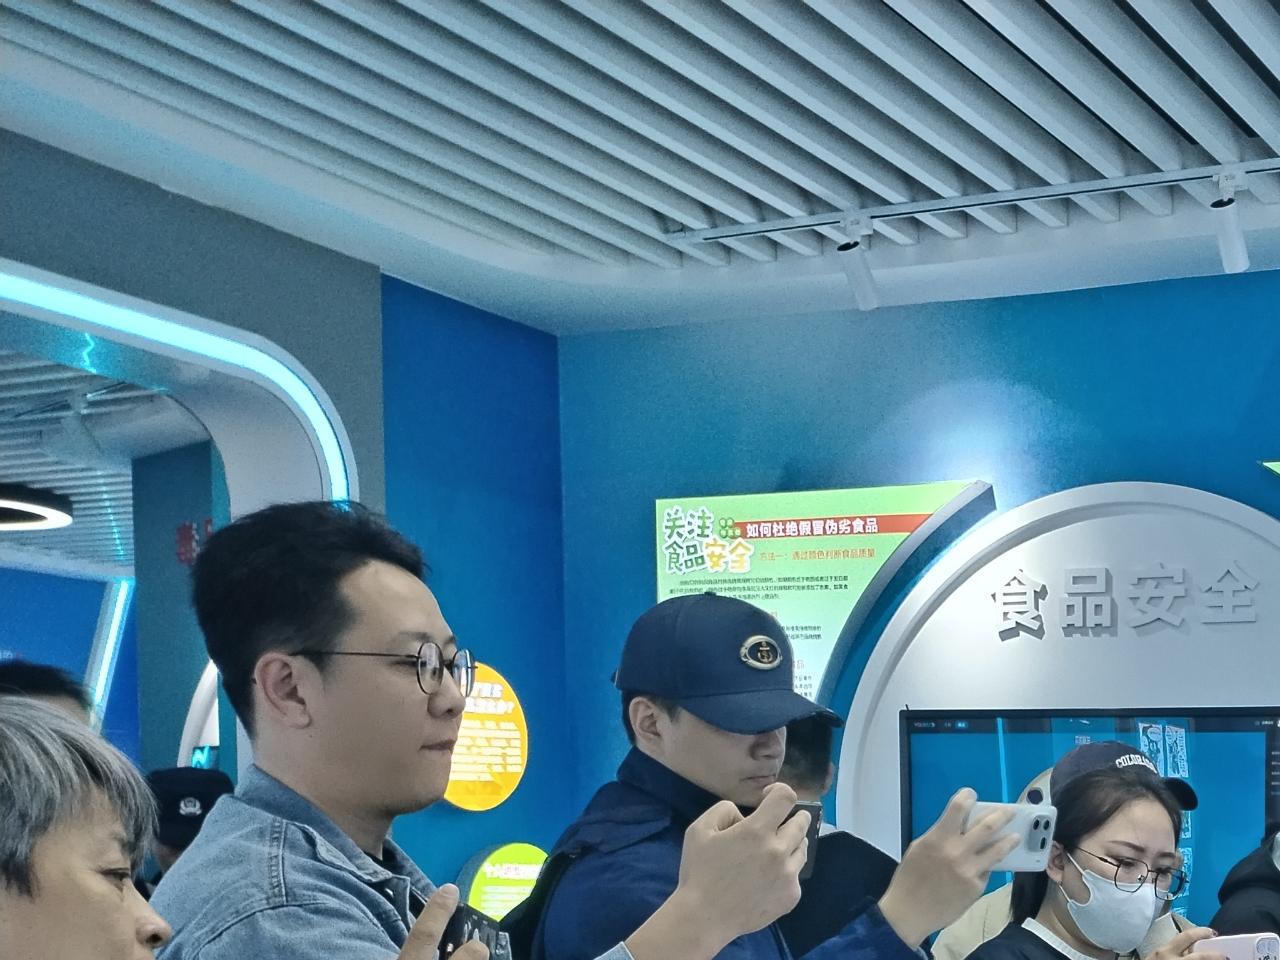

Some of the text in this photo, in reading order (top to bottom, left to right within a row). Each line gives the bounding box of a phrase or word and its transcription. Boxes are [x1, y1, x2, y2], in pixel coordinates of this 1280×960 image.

[664, 508, 713, 539] 关注
[746, 517, 879, 538] 如何杜绝假冒伪劣食品
[664, 539, 753, 573] 食品安全
[991, 562, 1260, 634] 食品安全
